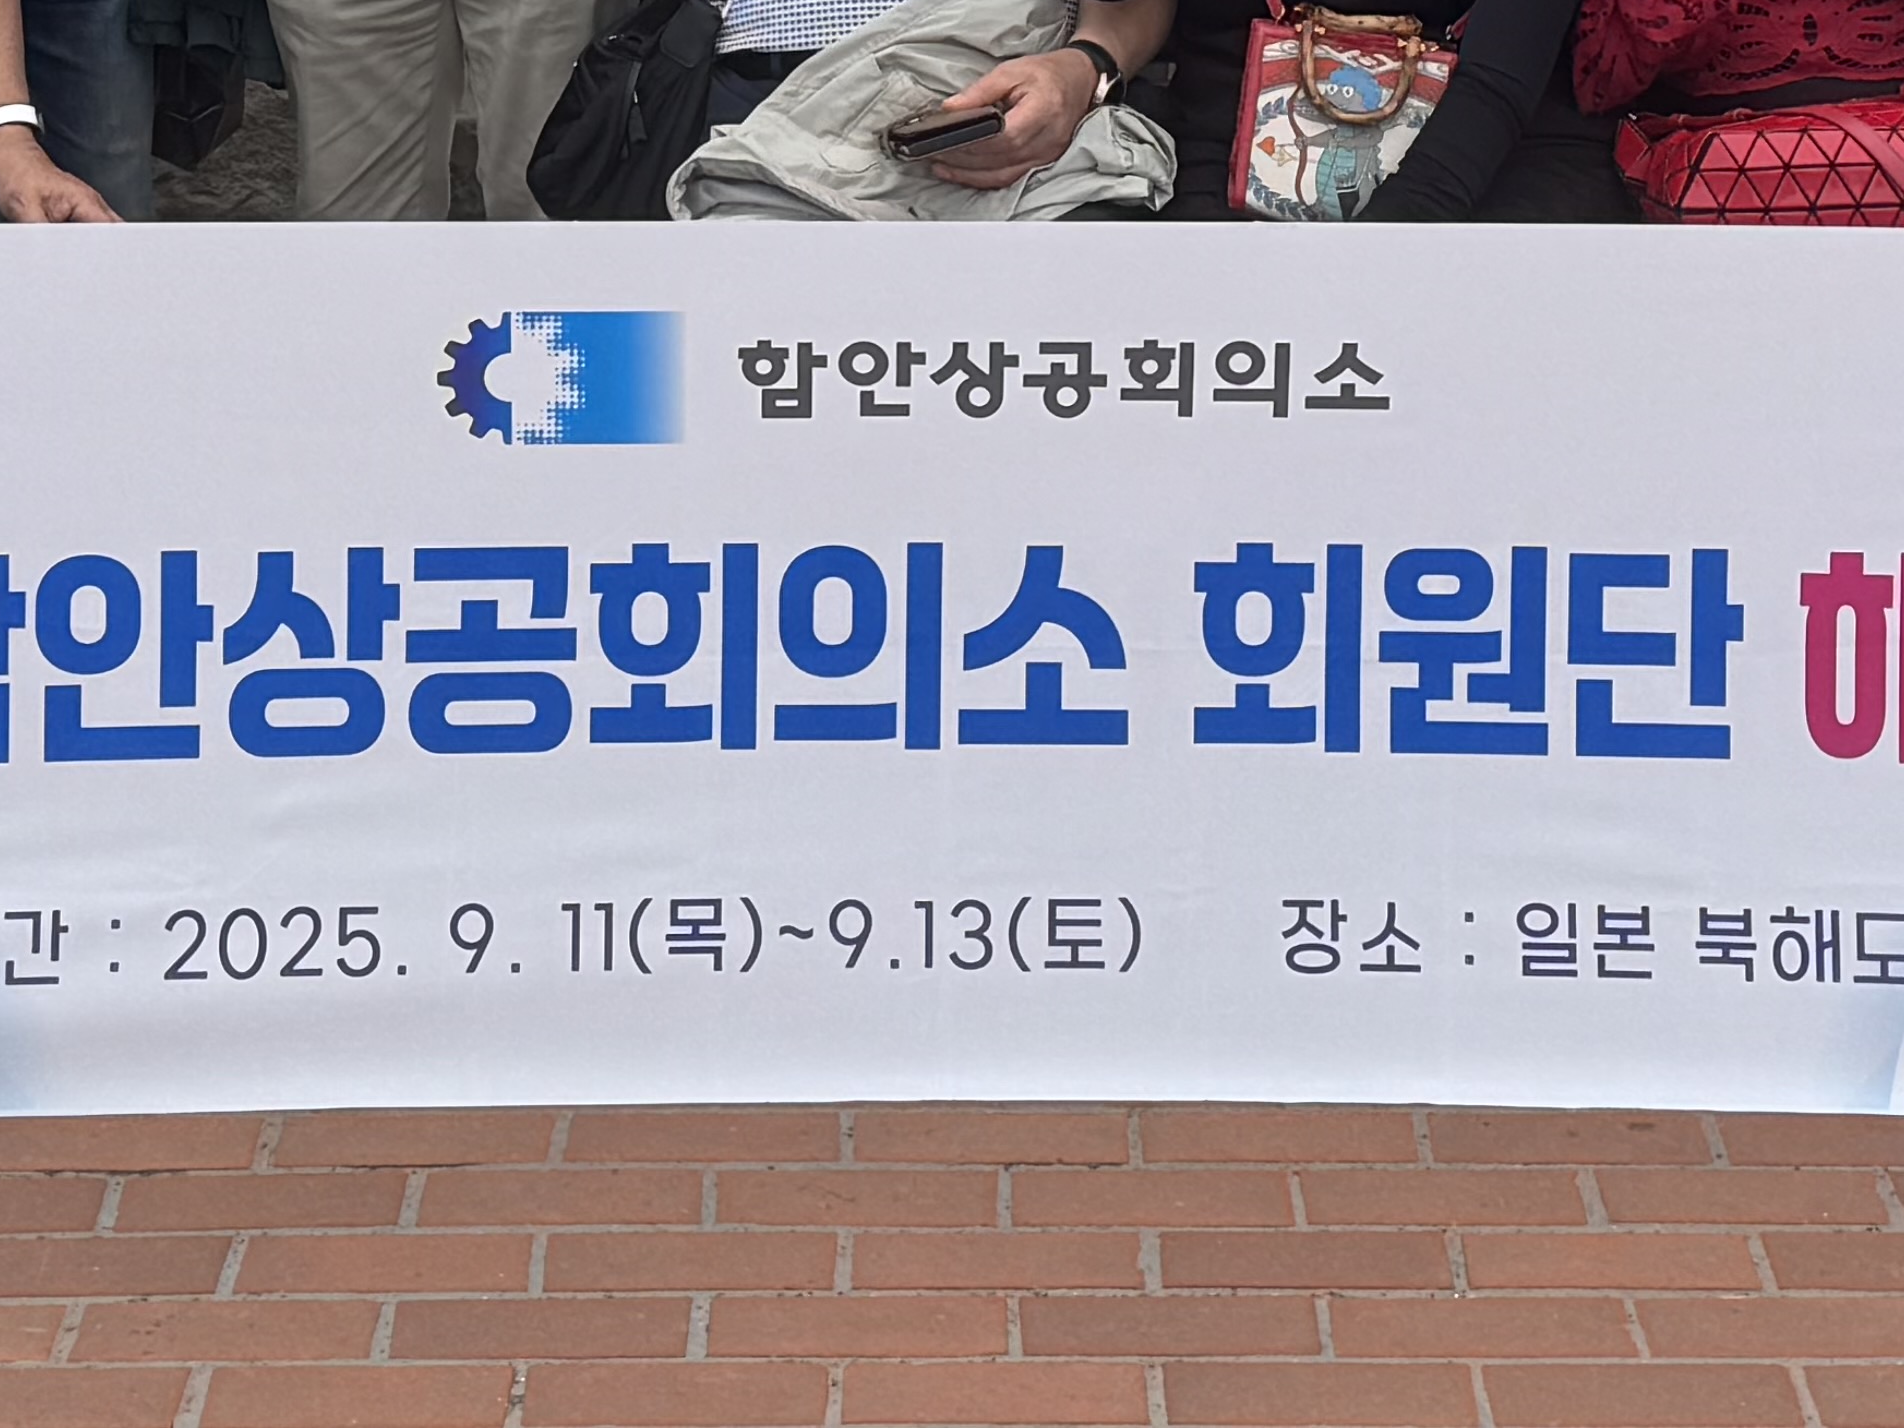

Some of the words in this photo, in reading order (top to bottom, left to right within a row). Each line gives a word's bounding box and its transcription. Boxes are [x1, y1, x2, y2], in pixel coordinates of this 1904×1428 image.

[737, 339, 1391, 419] 함안상공회의소
[1193, 542, 1744, 759] 회원단
[163, 906, 407, 981] 2025.
[449, 903, 521, 974] 9.
[561, 896, 1142, 974] 11(목)~9.13(토)
[1281, 899, 1423, 975] 장소
[1516, 902, 1656, 980] 일본
